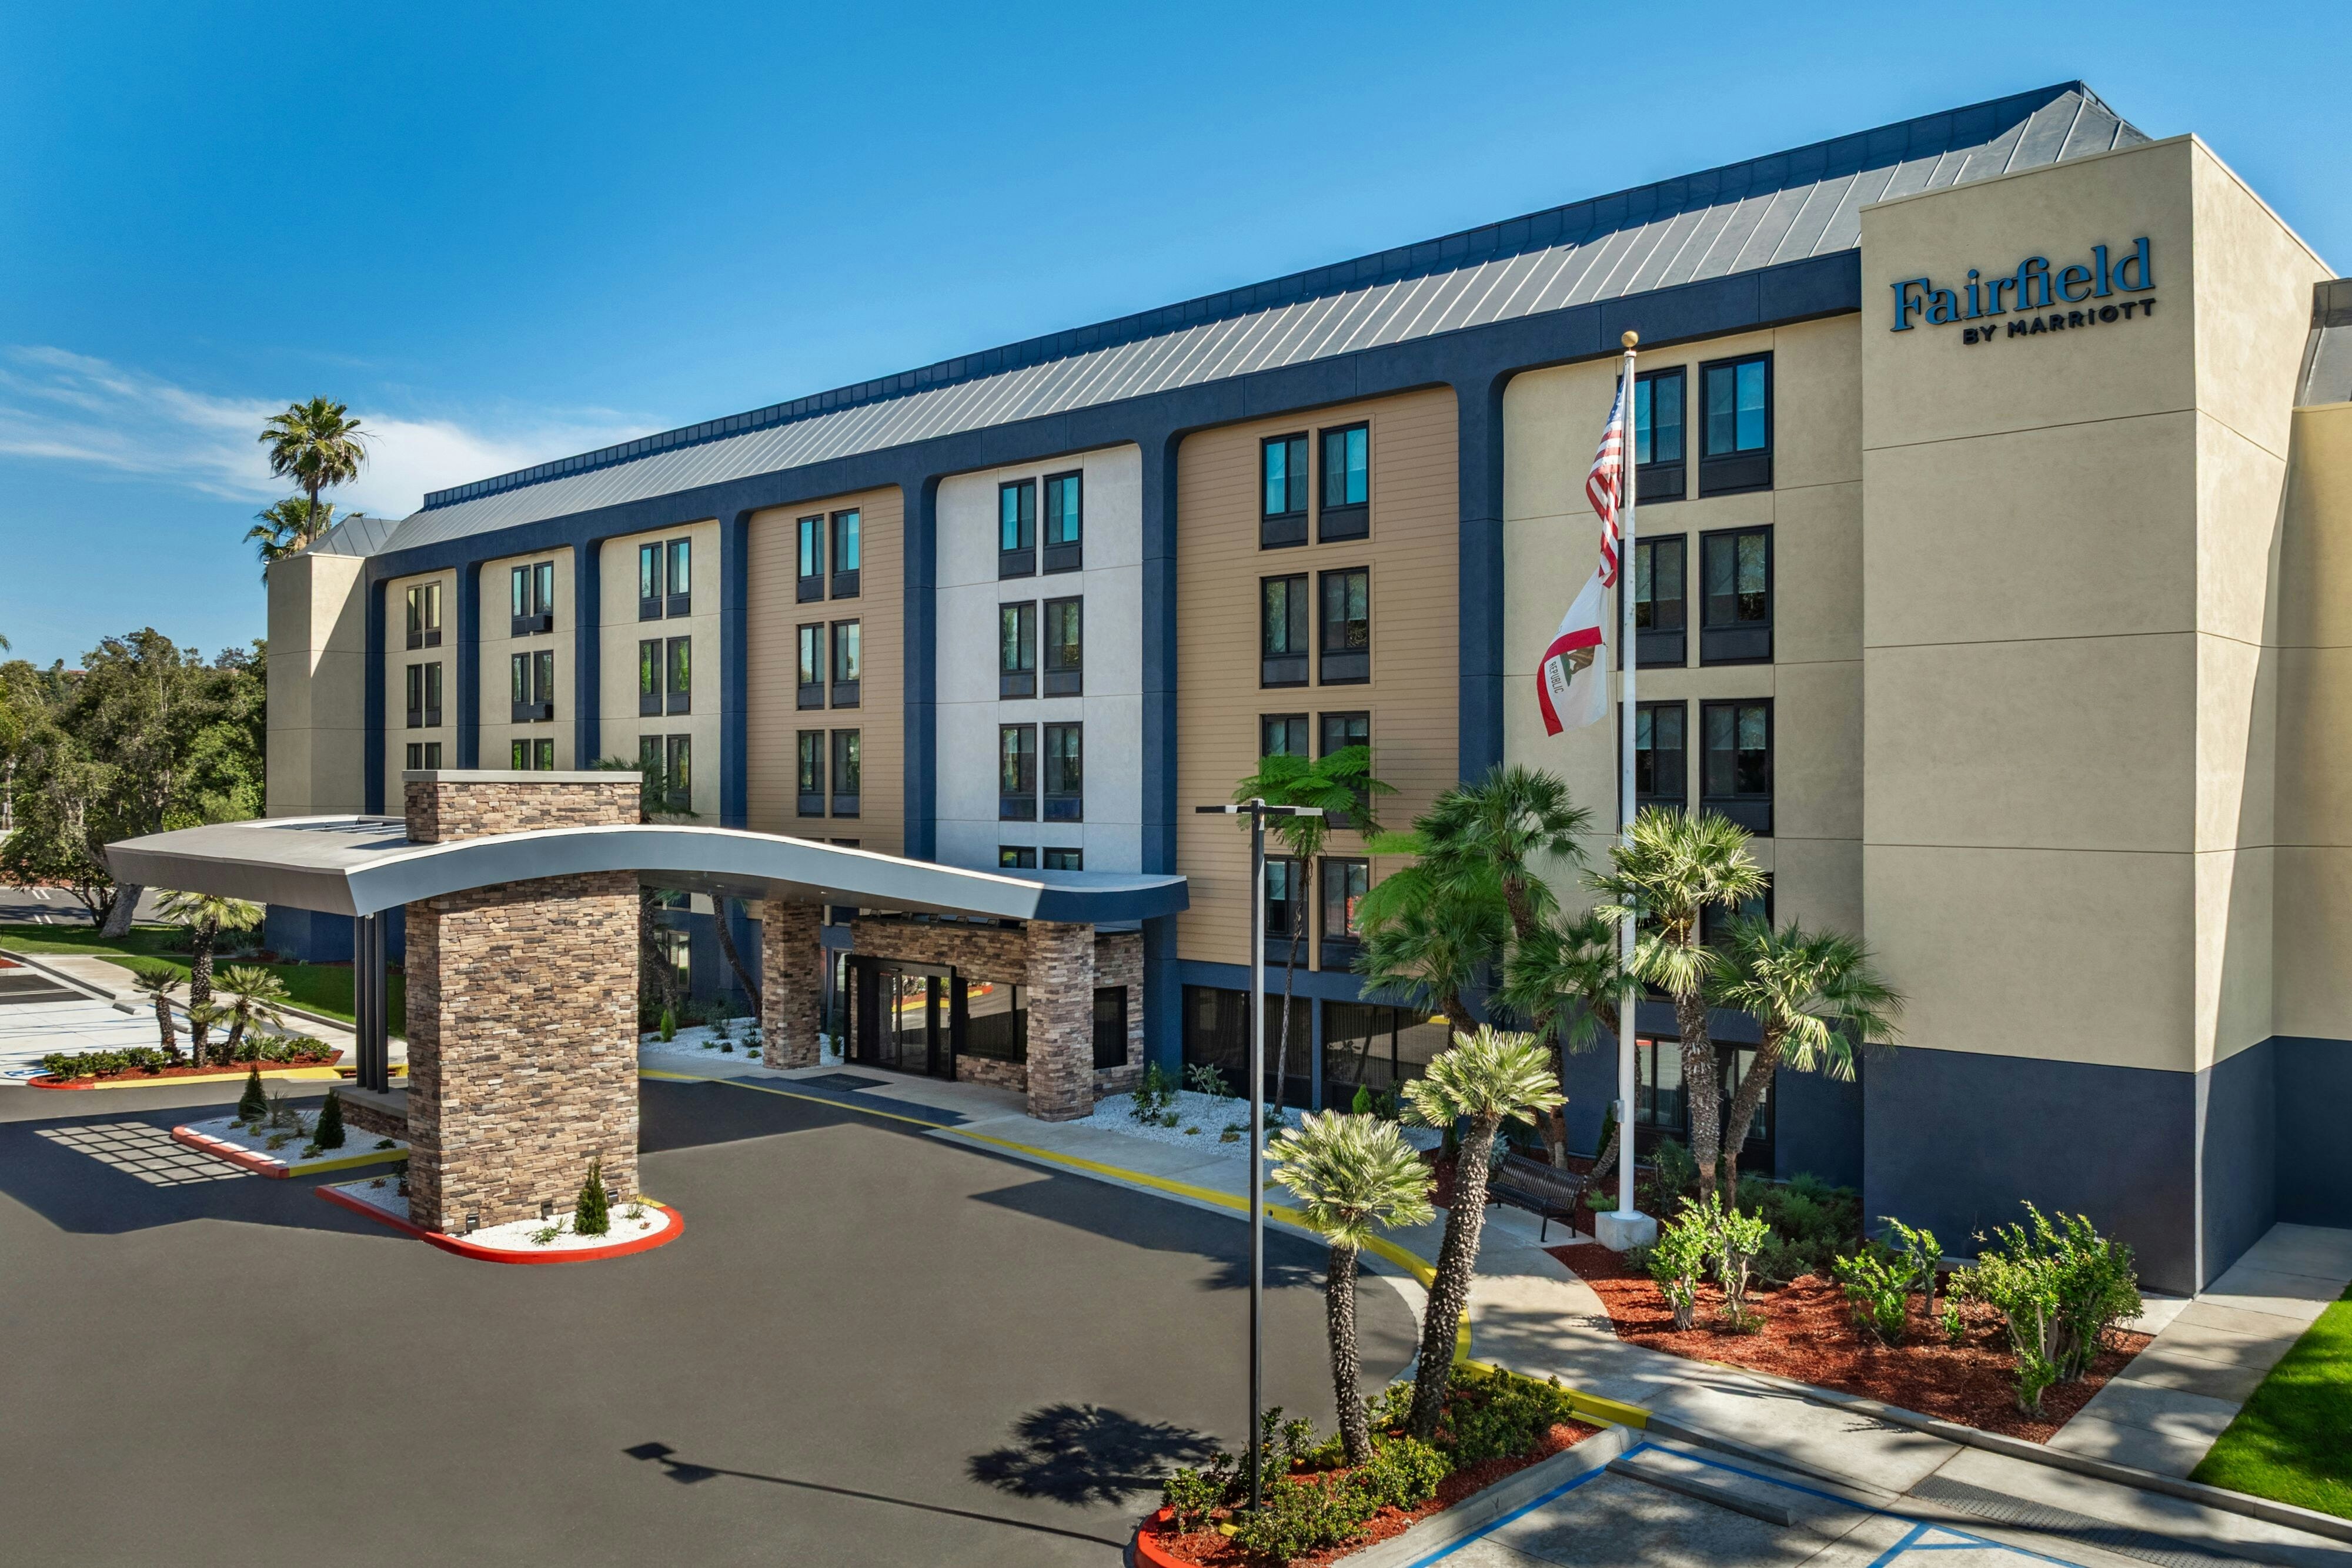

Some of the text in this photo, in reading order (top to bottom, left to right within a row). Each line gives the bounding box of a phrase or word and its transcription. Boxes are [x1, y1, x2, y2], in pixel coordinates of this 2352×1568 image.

[1890, 236, 2155, 332] Fairfield
[1963, 297, 2156, 345] BY MARRIOTT
[1549, 661, 1564, 694] REPUBLIC
